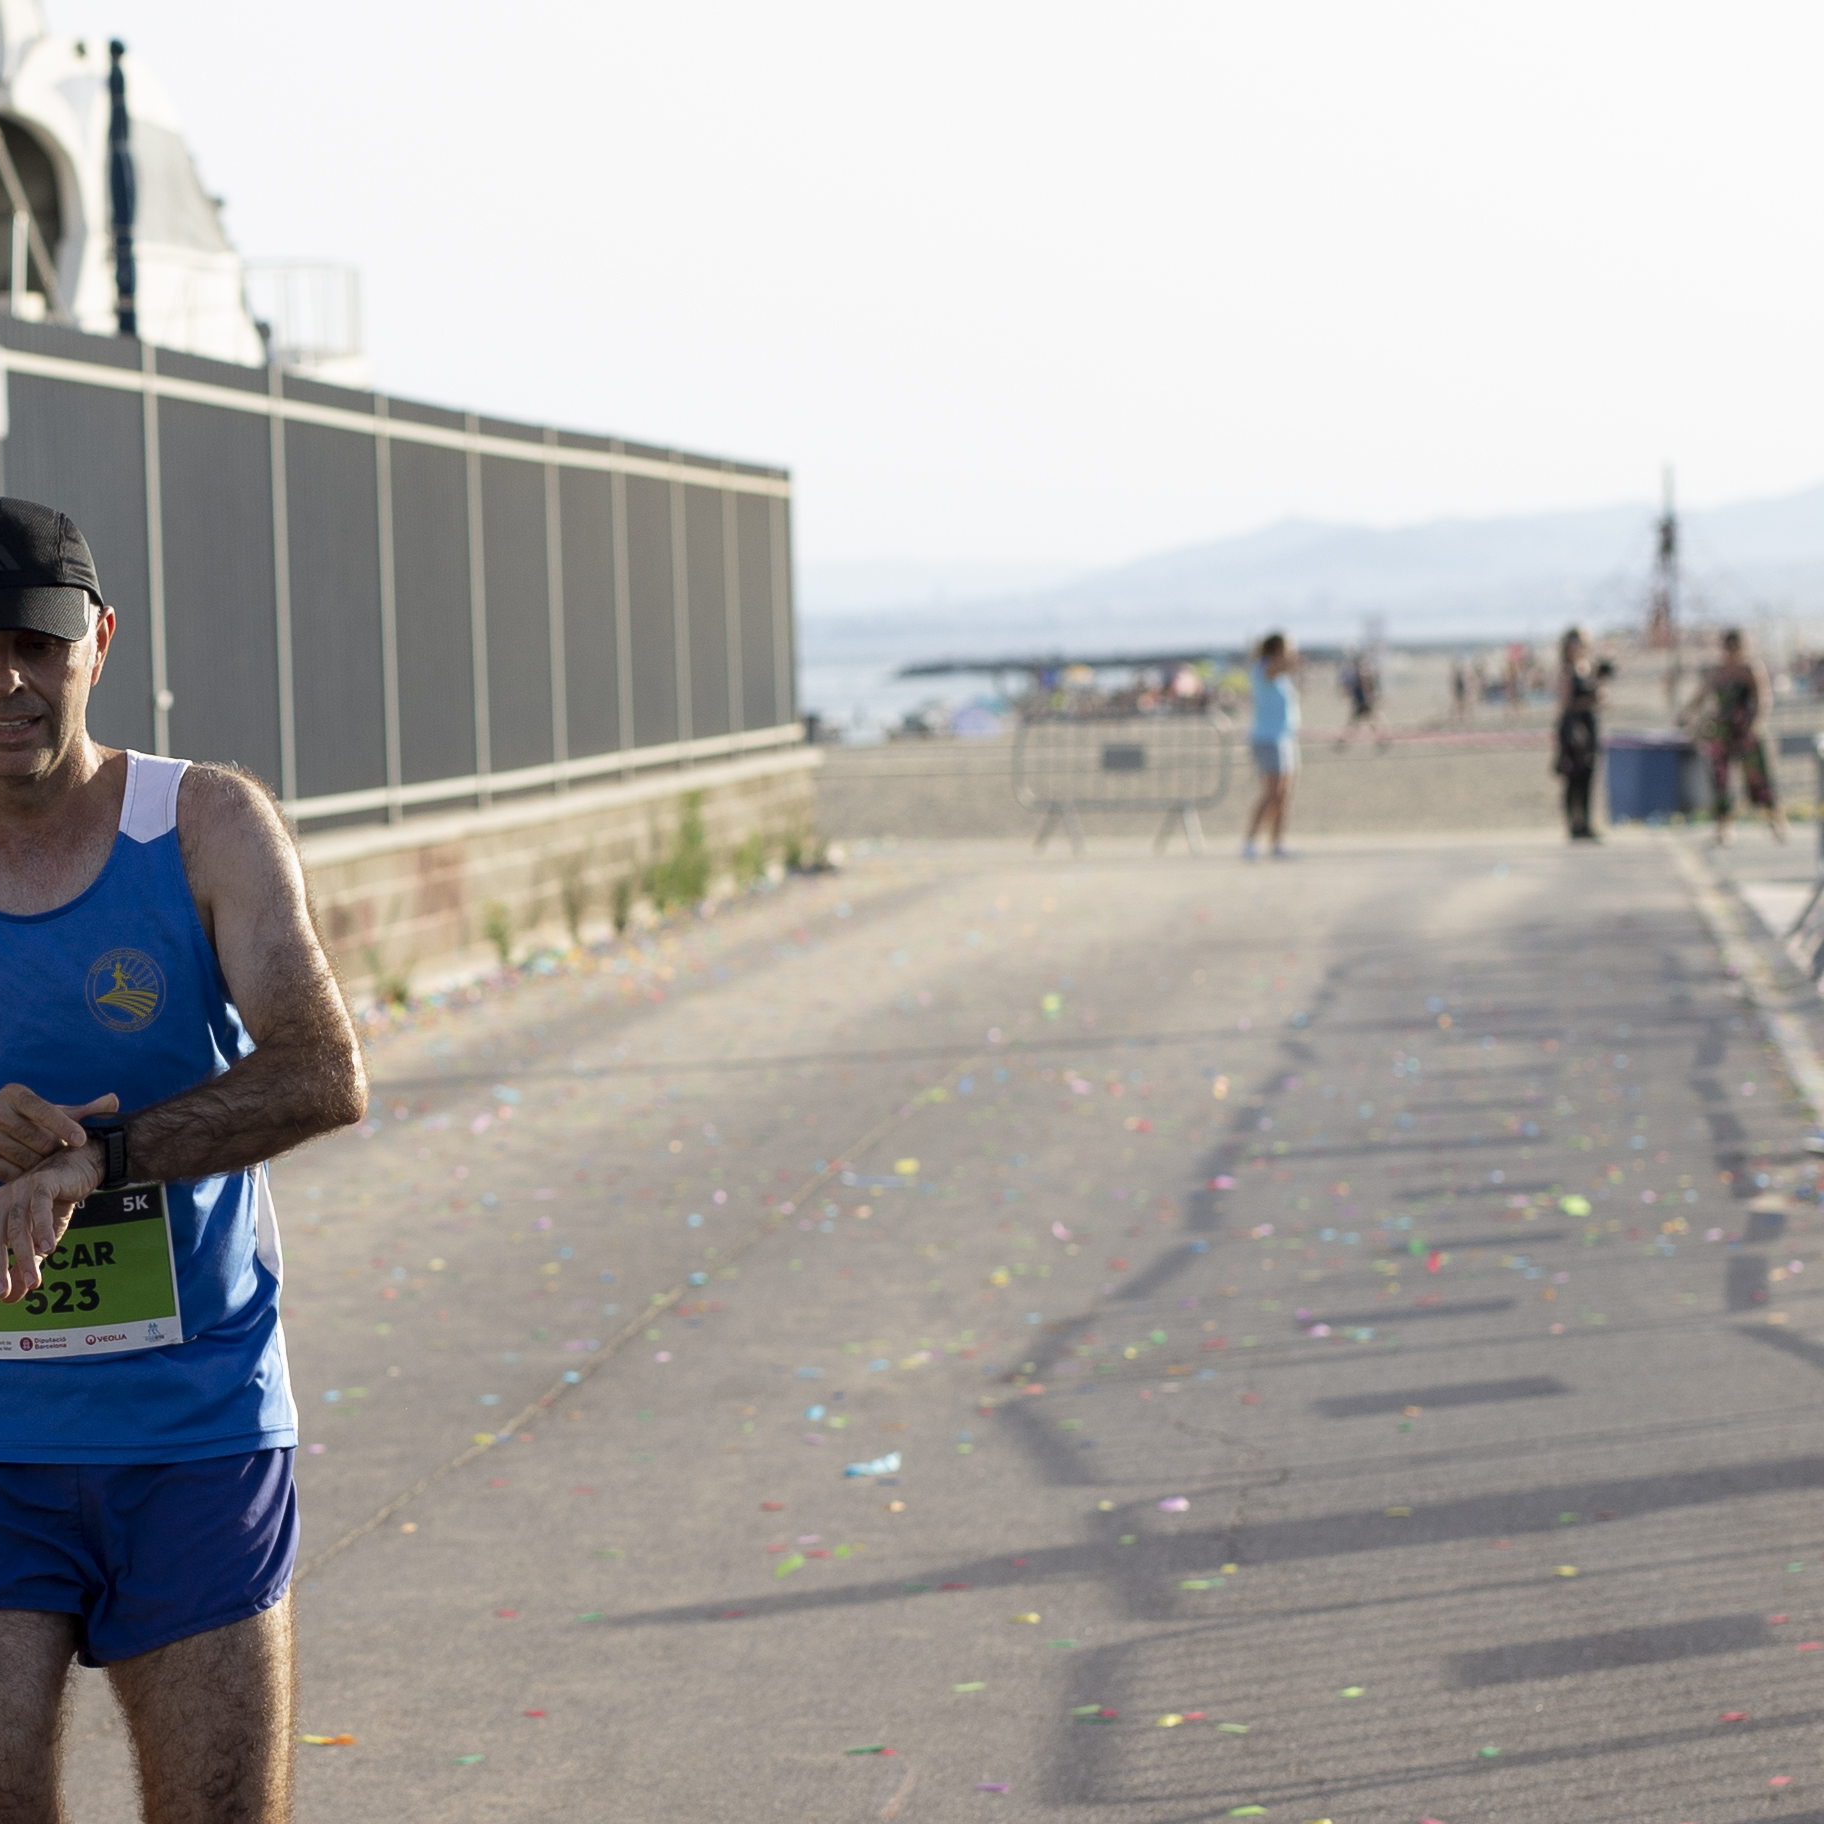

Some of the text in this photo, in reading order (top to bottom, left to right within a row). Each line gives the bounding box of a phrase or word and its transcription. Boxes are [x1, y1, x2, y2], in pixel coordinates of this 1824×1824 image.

[123, 1194, 149, 1212] 5K
[7, 1241, 116, 1271] CAR
[24, 1278, 101, 1315] 523
[33, 1336, 67, 1345] Diputació
[96, 1333, 128, 1343] VEOLIA
